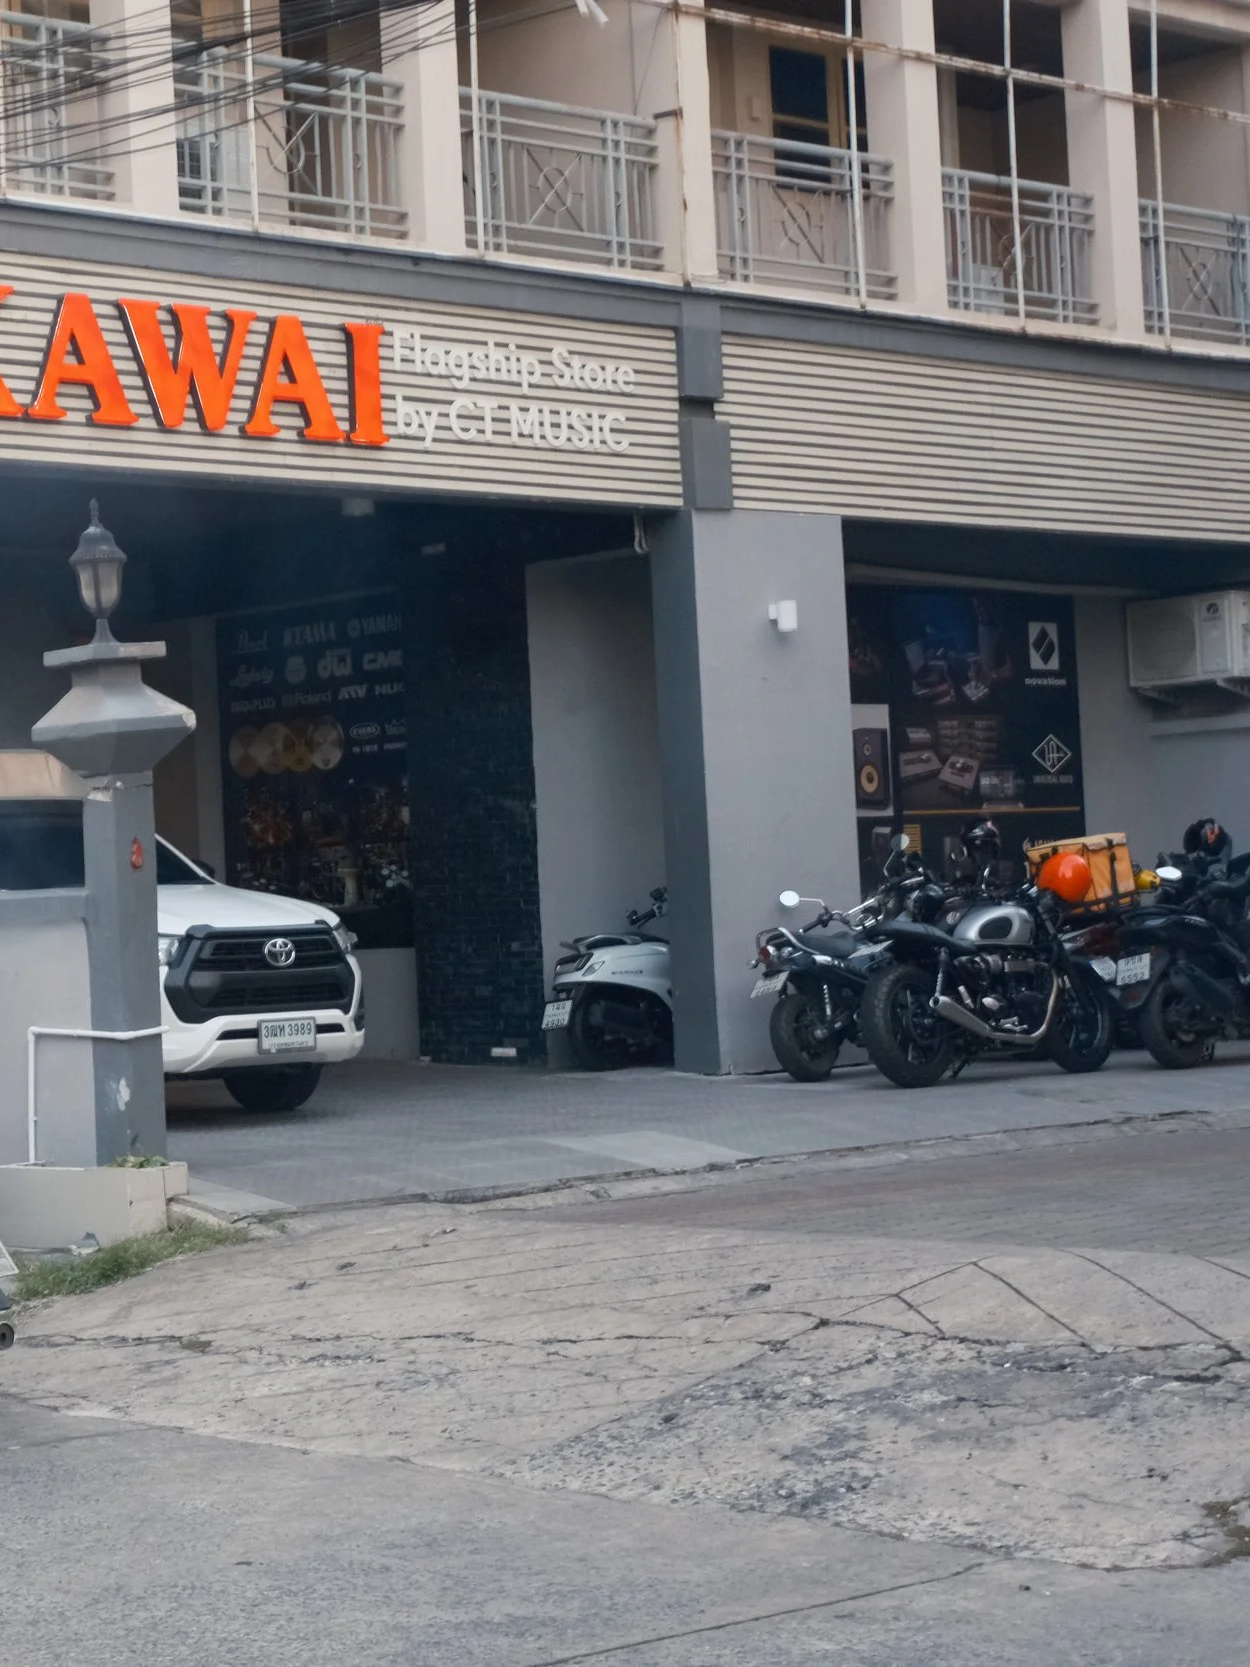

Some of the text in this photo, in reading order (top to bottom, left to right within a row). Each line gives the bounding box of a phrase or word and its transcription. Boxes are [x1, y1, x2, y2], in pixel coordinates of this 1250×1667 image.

[392, 330, 636, 395] Flagship Store
[395, 396, 631, 453] by CT MUSIC
[1024, 677, 1067, 686] novation
[287, 1022, 312, 1036] 3989
